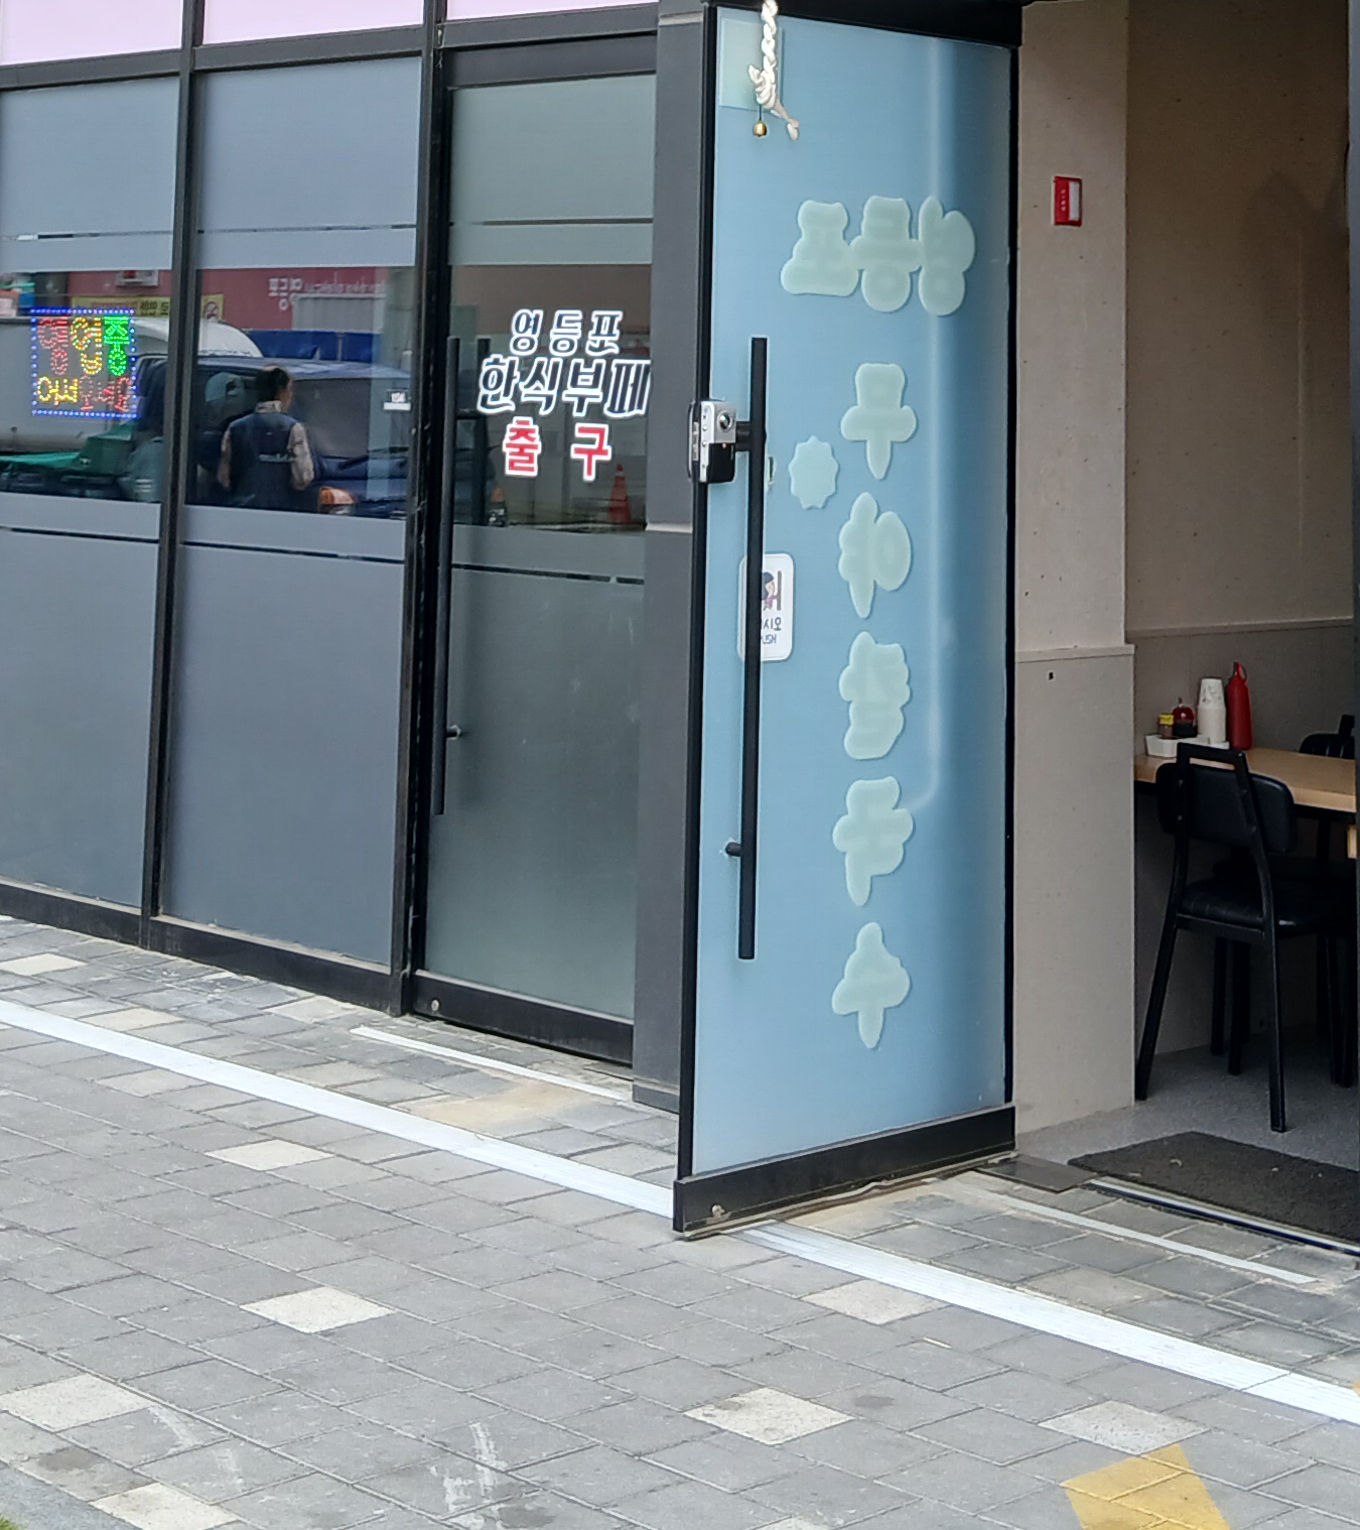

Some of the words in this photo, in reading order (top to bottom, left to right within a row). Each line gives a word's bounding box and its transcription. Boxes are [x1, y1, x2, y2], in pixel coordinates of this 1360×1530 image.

[38, 316, 130, 376] 영업중
[510, 309, 623, 356] 영등포
[476, 354, 652, 419] 한식부페
[502, 416, 613, 482] 출구
